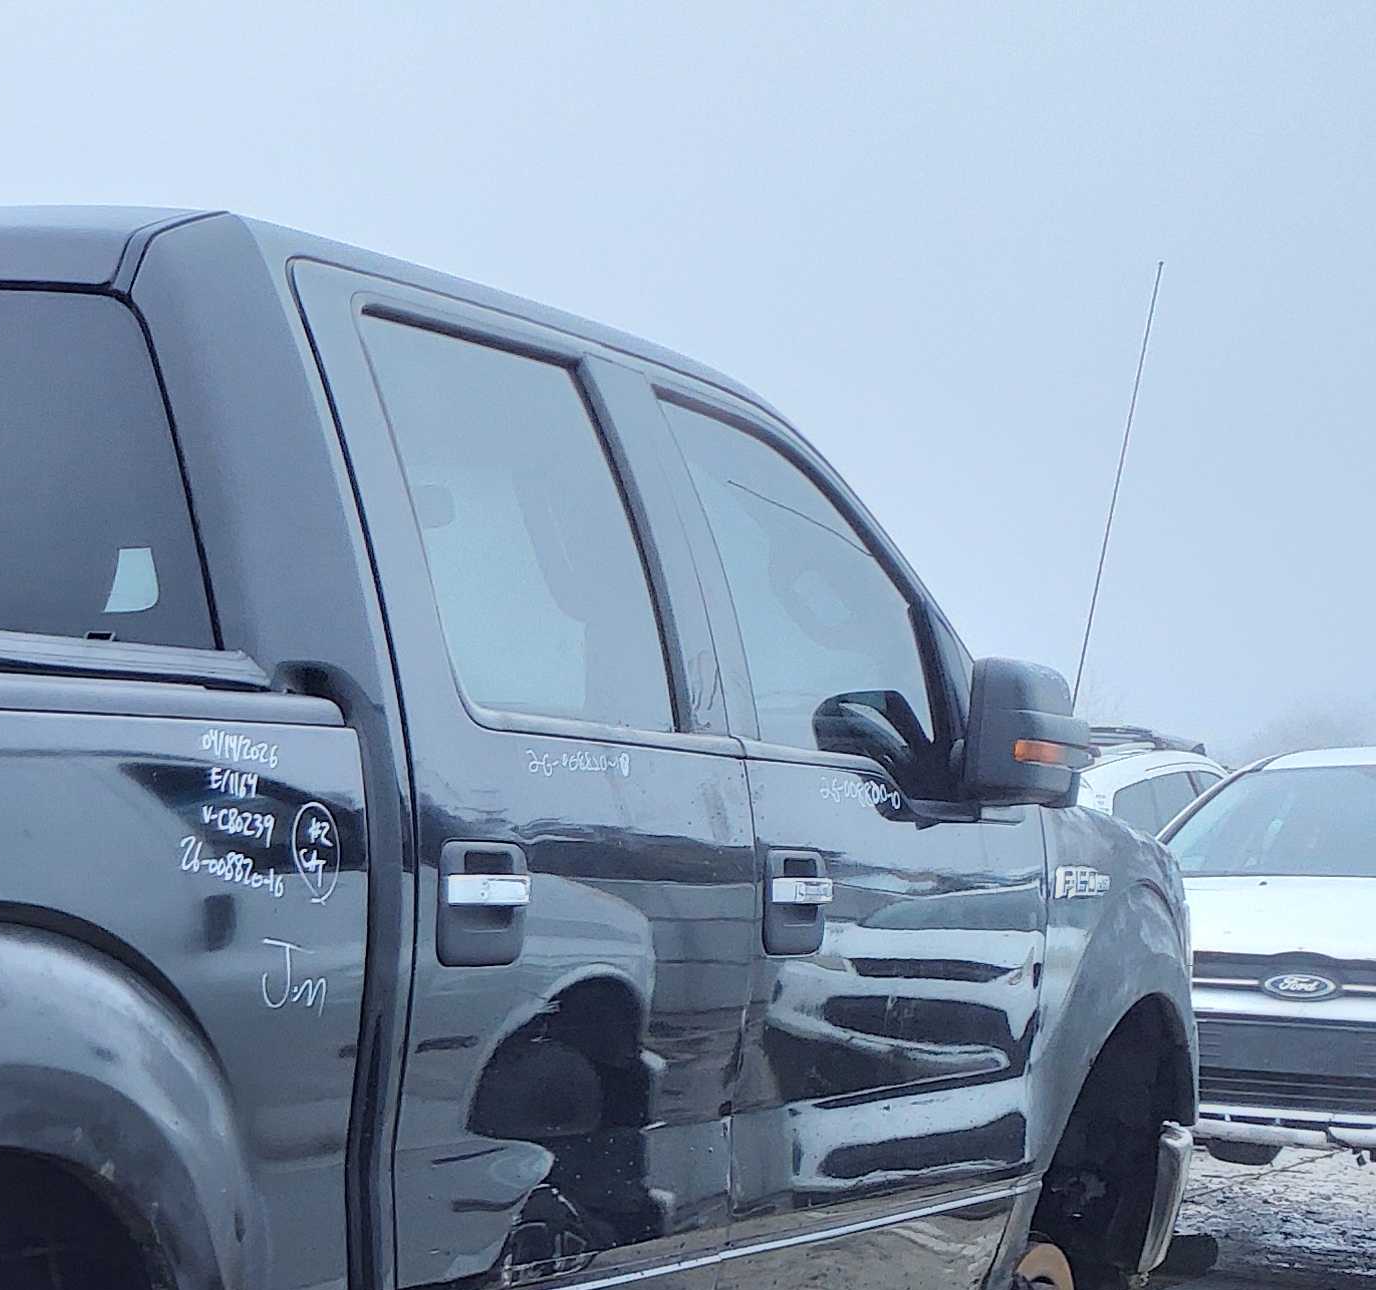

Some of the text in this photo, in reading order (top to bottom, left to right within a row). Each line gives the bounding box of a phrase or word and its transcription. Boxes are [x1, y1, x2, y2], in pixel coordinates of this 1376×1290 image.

[202, 728, 279, 769] 04/14/2026
[179, 835, 285, 898] 26-008820-16
[1278, 976, 1321, 992] Ford
